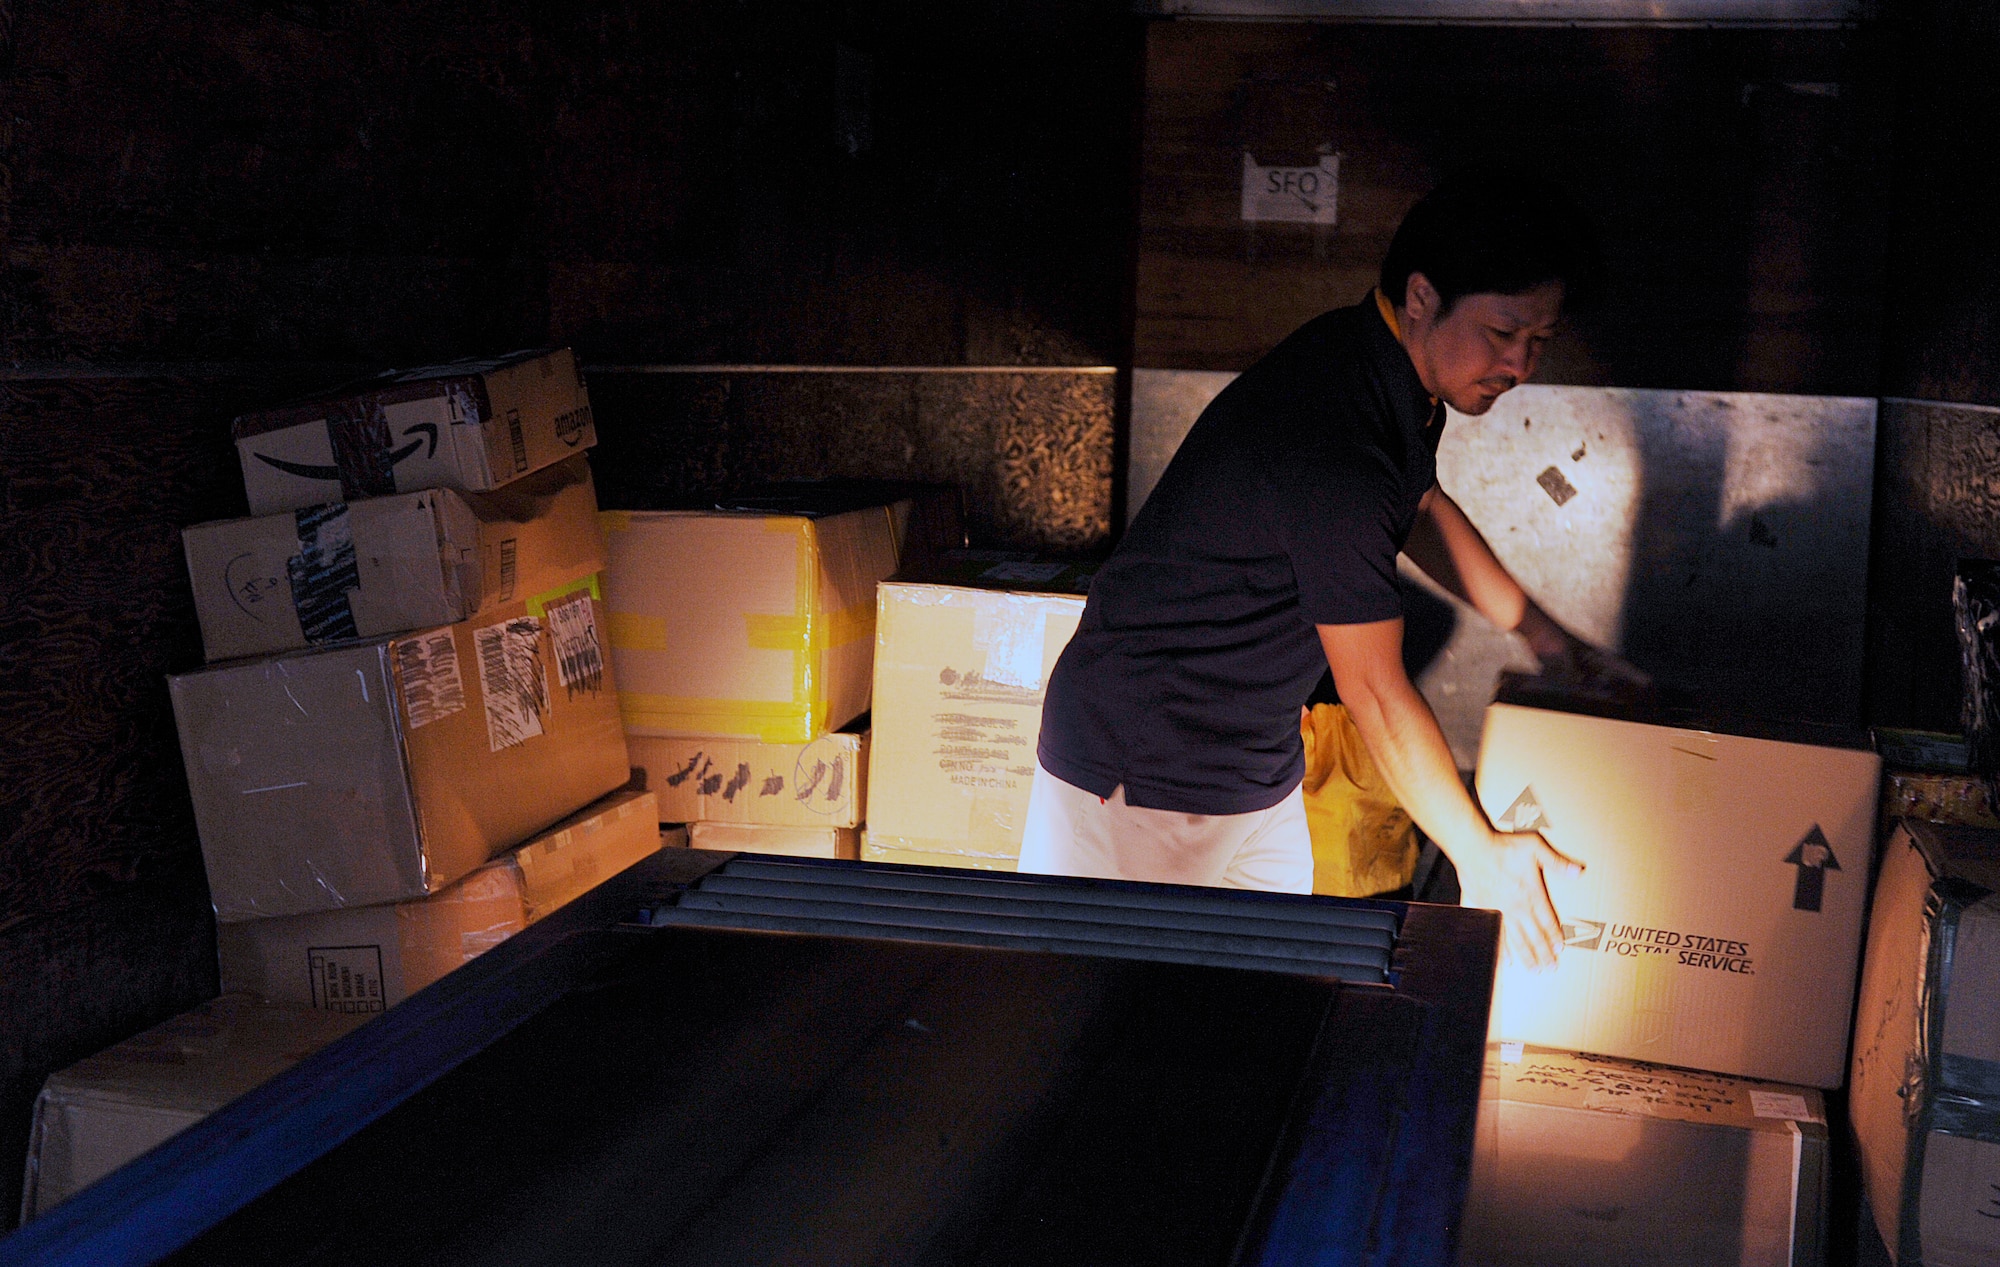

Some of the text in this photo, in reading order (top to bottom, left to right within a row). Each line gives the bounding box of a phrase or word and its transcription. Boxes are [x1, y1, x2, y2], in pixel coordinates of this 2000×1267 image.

[1267, 170, 1319, 195] SFO
[555, 406, 591, 438] amazon
[1611, 924, 1749, 957] UNITED STATES
